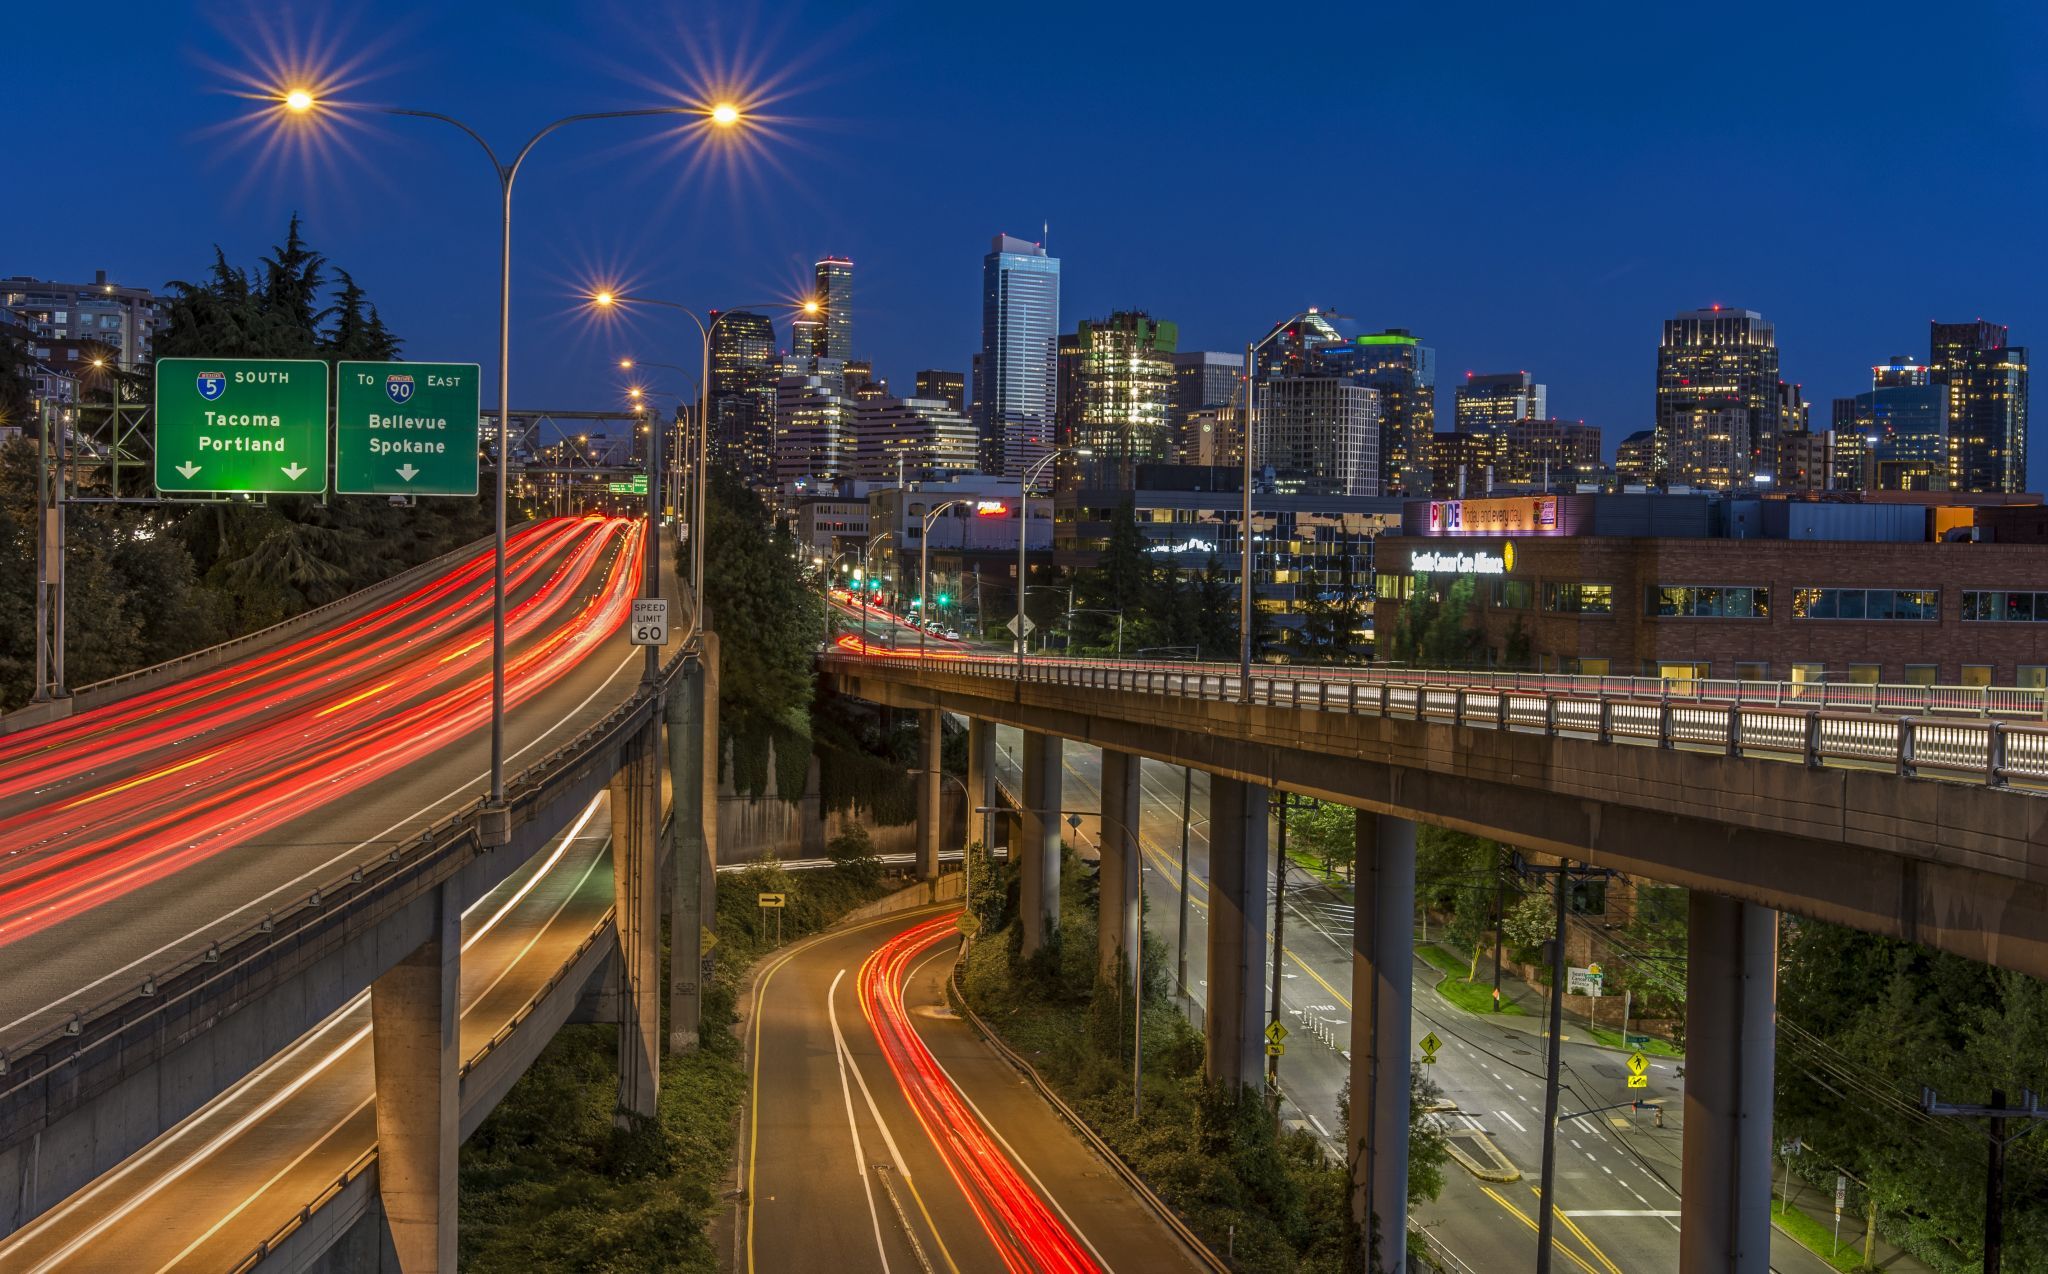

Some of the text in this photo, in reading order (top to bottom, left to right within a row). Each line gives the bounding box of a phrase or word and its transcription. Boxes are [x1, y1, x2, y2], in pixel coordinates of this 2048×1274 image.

[206, 379, 217, 395] 5
[235, 372, 289, 384] SOUTH
[390, 384, 410, 398] 90
[427, 375, 461, 387] EAST
[204, 411, 280, 427] Tacoma
[369, 414, 447, 430] Bellevue
[199, 436, 285, 452] Portland
[369, 437, 445, 456] Spokane
[1431, 503, 1460, 528] PRIDE
[1464, 507, 1480, 528] Today
[1480, 505, 1492, 524] and
[1492, 507, 1509, 529] every
[1510, 504, 1522, 528] day
[634, 603, 666, 612] SPEED
[637, 615, 661, 623] LIMIT
[637, 626, 662, 640] 60
